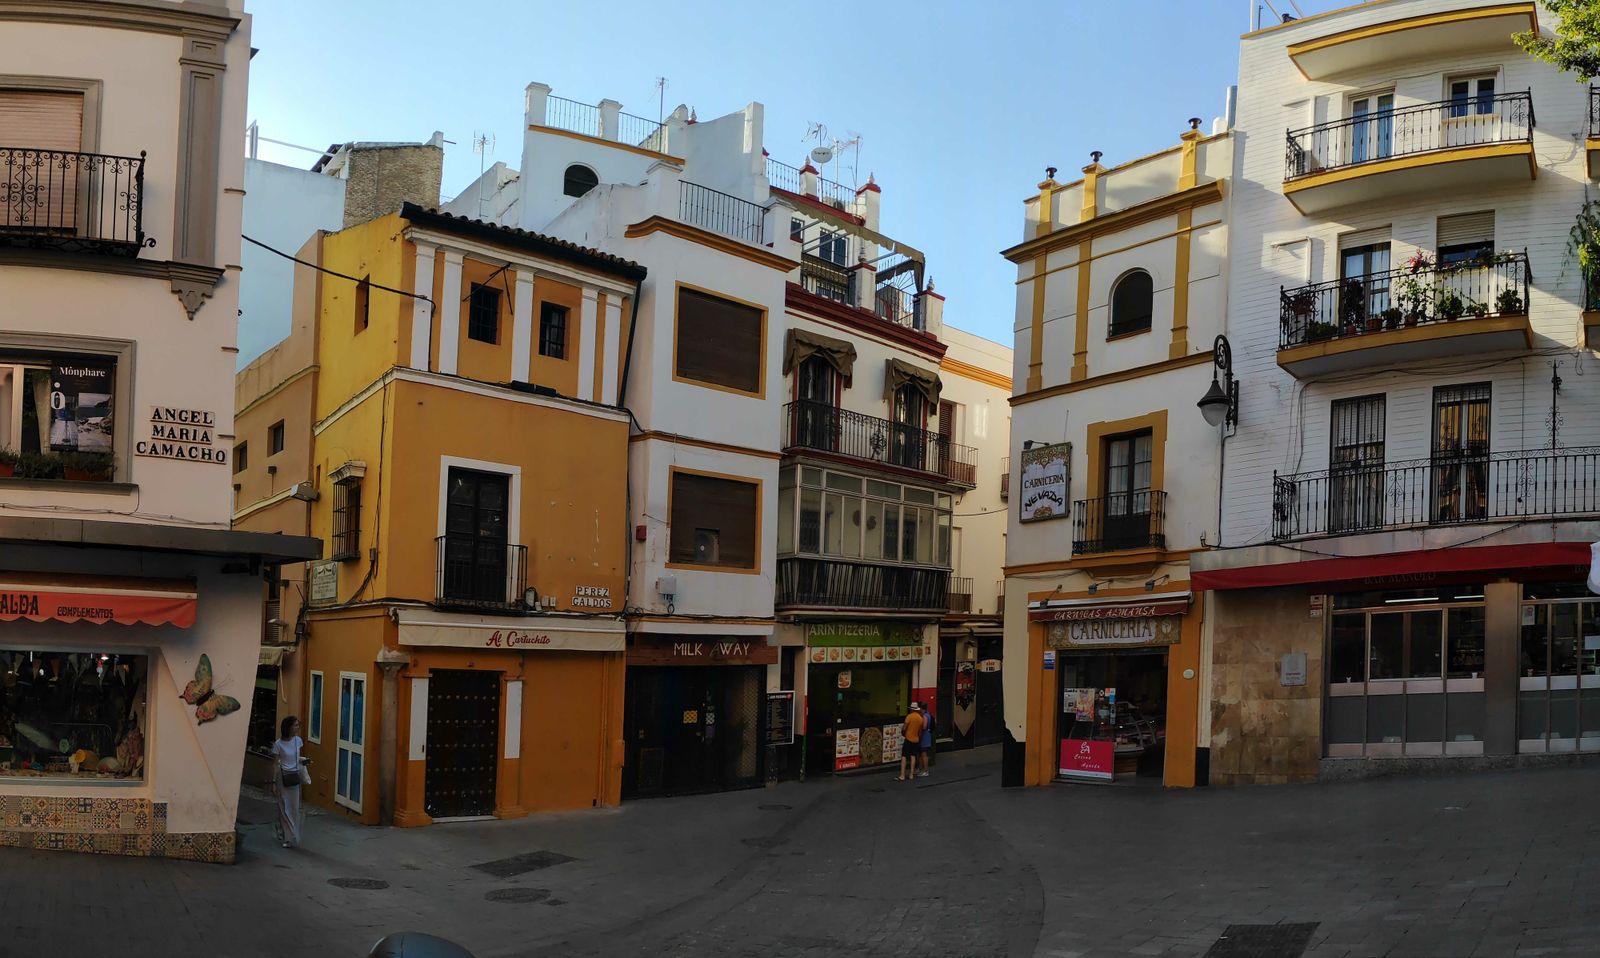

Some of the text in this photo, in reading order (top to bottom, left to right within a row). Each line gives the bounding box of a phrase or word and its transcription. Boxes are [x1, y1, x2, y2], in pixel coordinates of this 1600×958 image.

[152, 407, 213, 425] ANGEL
[152, 425, 211, 442] MARIA
[136, 441, 226, 462] CAMACHO
[1024, 473, 1065, 489] CARNICERIA
[1024, 490, 1063, 512] NEVADA
[577, 586, 609, 597] PEREZ
[572, 597, 611, 608] GALDOS
[57, 606, 114, 618] COMPLEMENTOS
[838, 623, 880, 636] PIZZERIA
[1071, 619, 1153, 640] CARNICERIA
[486, 630, 551, 647] Al Cartuchito
[673, 642, 703, 656] MILK
